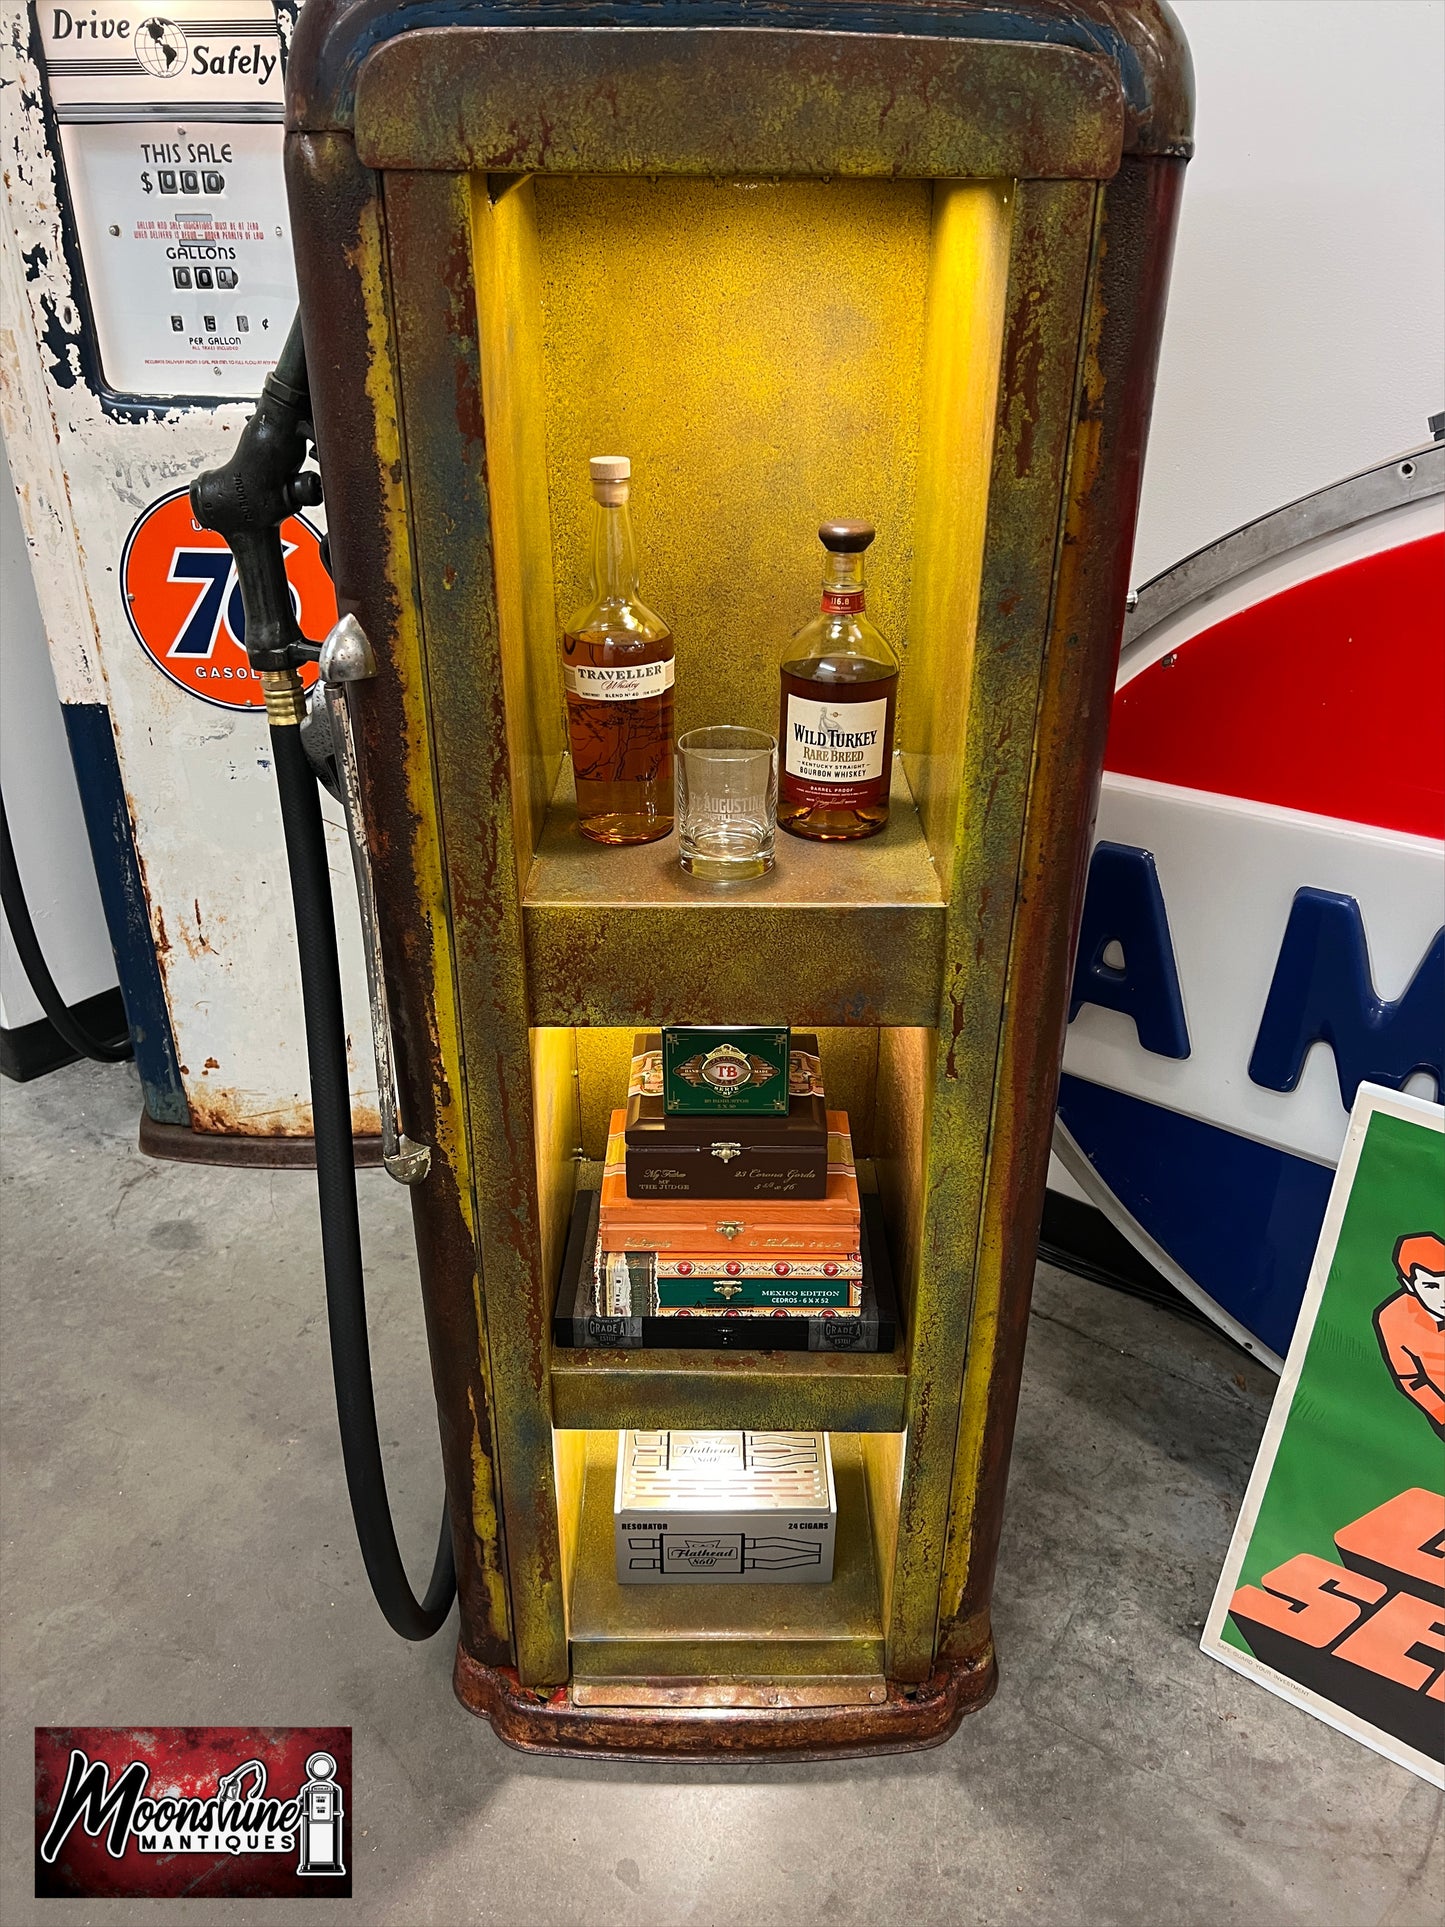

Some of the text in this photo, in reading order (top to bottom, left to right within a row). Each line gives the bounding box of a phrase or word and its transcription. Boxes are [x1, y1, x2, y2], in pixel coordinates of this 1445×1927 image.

[52, 9, 130, 40] Drive
[191, 44, 277, 85] Safely
[141, 143, 234, 163] THIS SALE
[166, 247, 237, 260] GALLONS
[189, 337, 242, 346] PER GALLON
[578, 665, 662, 681] TRAVELLER
[794, 723, 878, 749] WILD TURKEY
[803, 746, 864, 763] RARE BREED
[800, 766, 866, 778] BOURBON WHISKEY
[802, 761, 832, 770] KENTUCKY
[716, 1066, 738, 1078] TB
[749, 1169, 784, 1178] Corona
[784, 1169, 816, 1184] Gorda
[590, 1320, 618, 1334] GRADE
[620, 1322, 625, 1336] A
[826, 1324, 854, 1335] GRADE
[670, 1548, 735, 1558] Flathead
[1228, 1553, 1445, 1703] SE
